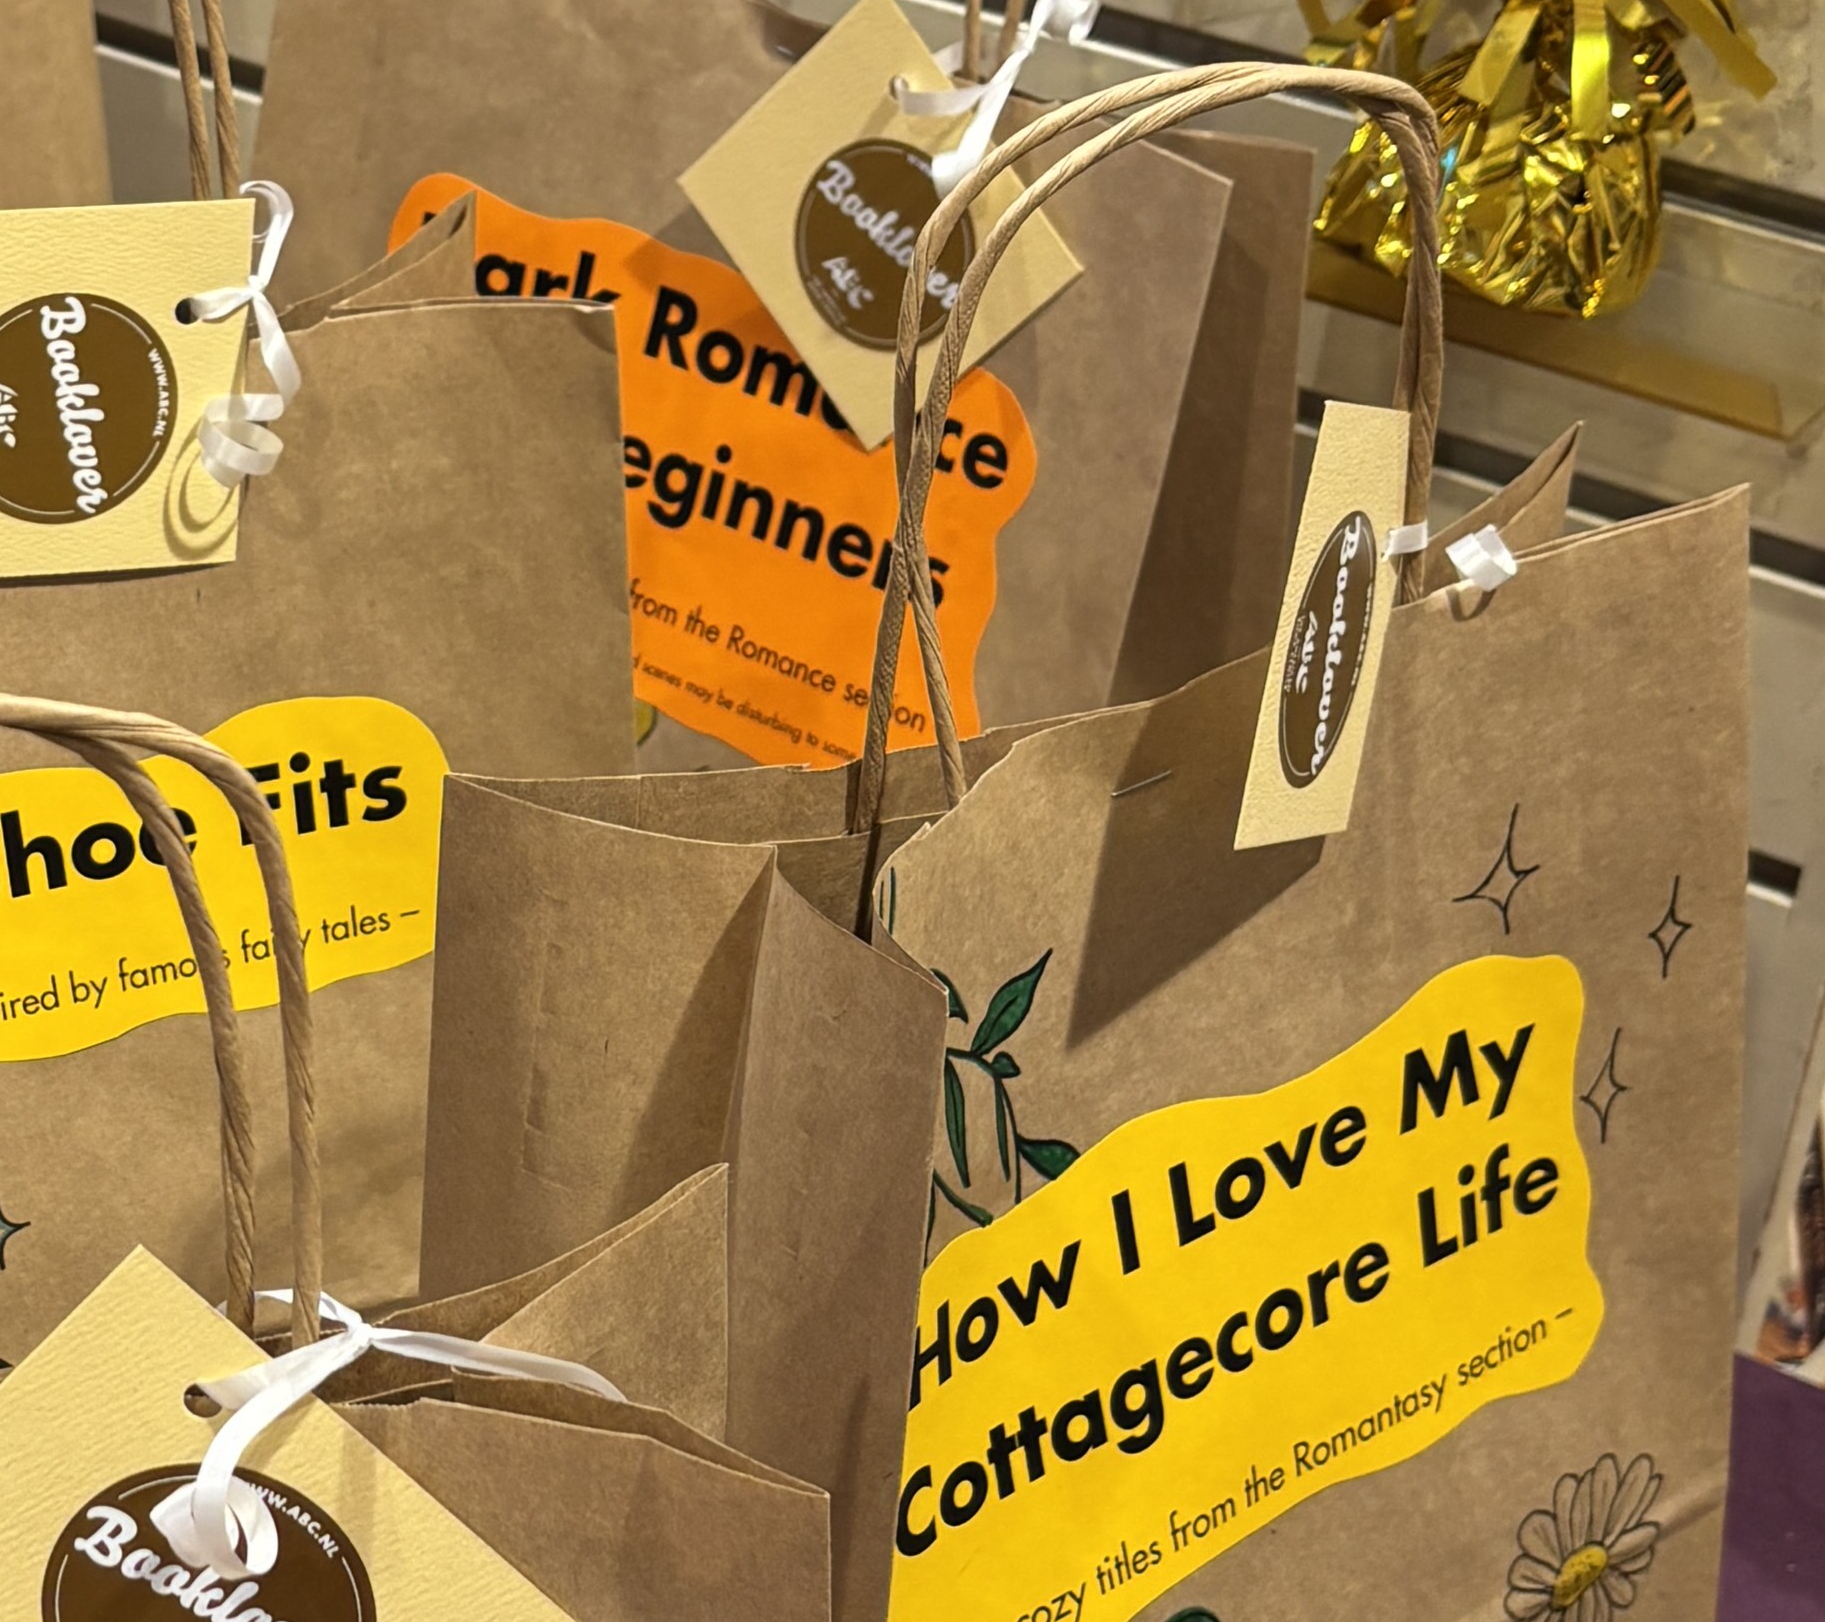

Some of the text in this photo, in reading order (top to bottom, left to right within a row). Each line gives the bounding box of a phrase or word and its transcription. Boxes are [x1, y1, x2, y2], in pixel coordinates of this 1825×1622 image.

[39, 296, 109, 515] Booklover
[147, 347, 170, 437] WWW.ABC.NL
[475, 251, 1009, 490] ark Romce
[621, 433, 951, 609] eginners
[630, 577, 926, 733] from the Romance seon
[1310, 515, 1361, 776] Booklover
[69, 968, 108, 1011] by
[119, 949, 231, 994] famos
[240, 928, 312, 964] faiy
[320, 904, 392, 945] tales
[908, 1023, 1536, 1413] How I Love My
[894, 1143, 1561, 1558] Cottagecore Life
[1094, 1538, 1164, 1597] titles
[1170, 1499, 1238, 1553] from
[1243, 1463, 1287, 1510] the
[1292, 1373, 1450, 1477] Romantasy
[1455, 1312, 1549, 1388] section
[245, 1482, 341, 1559] WW.ABC.NL
